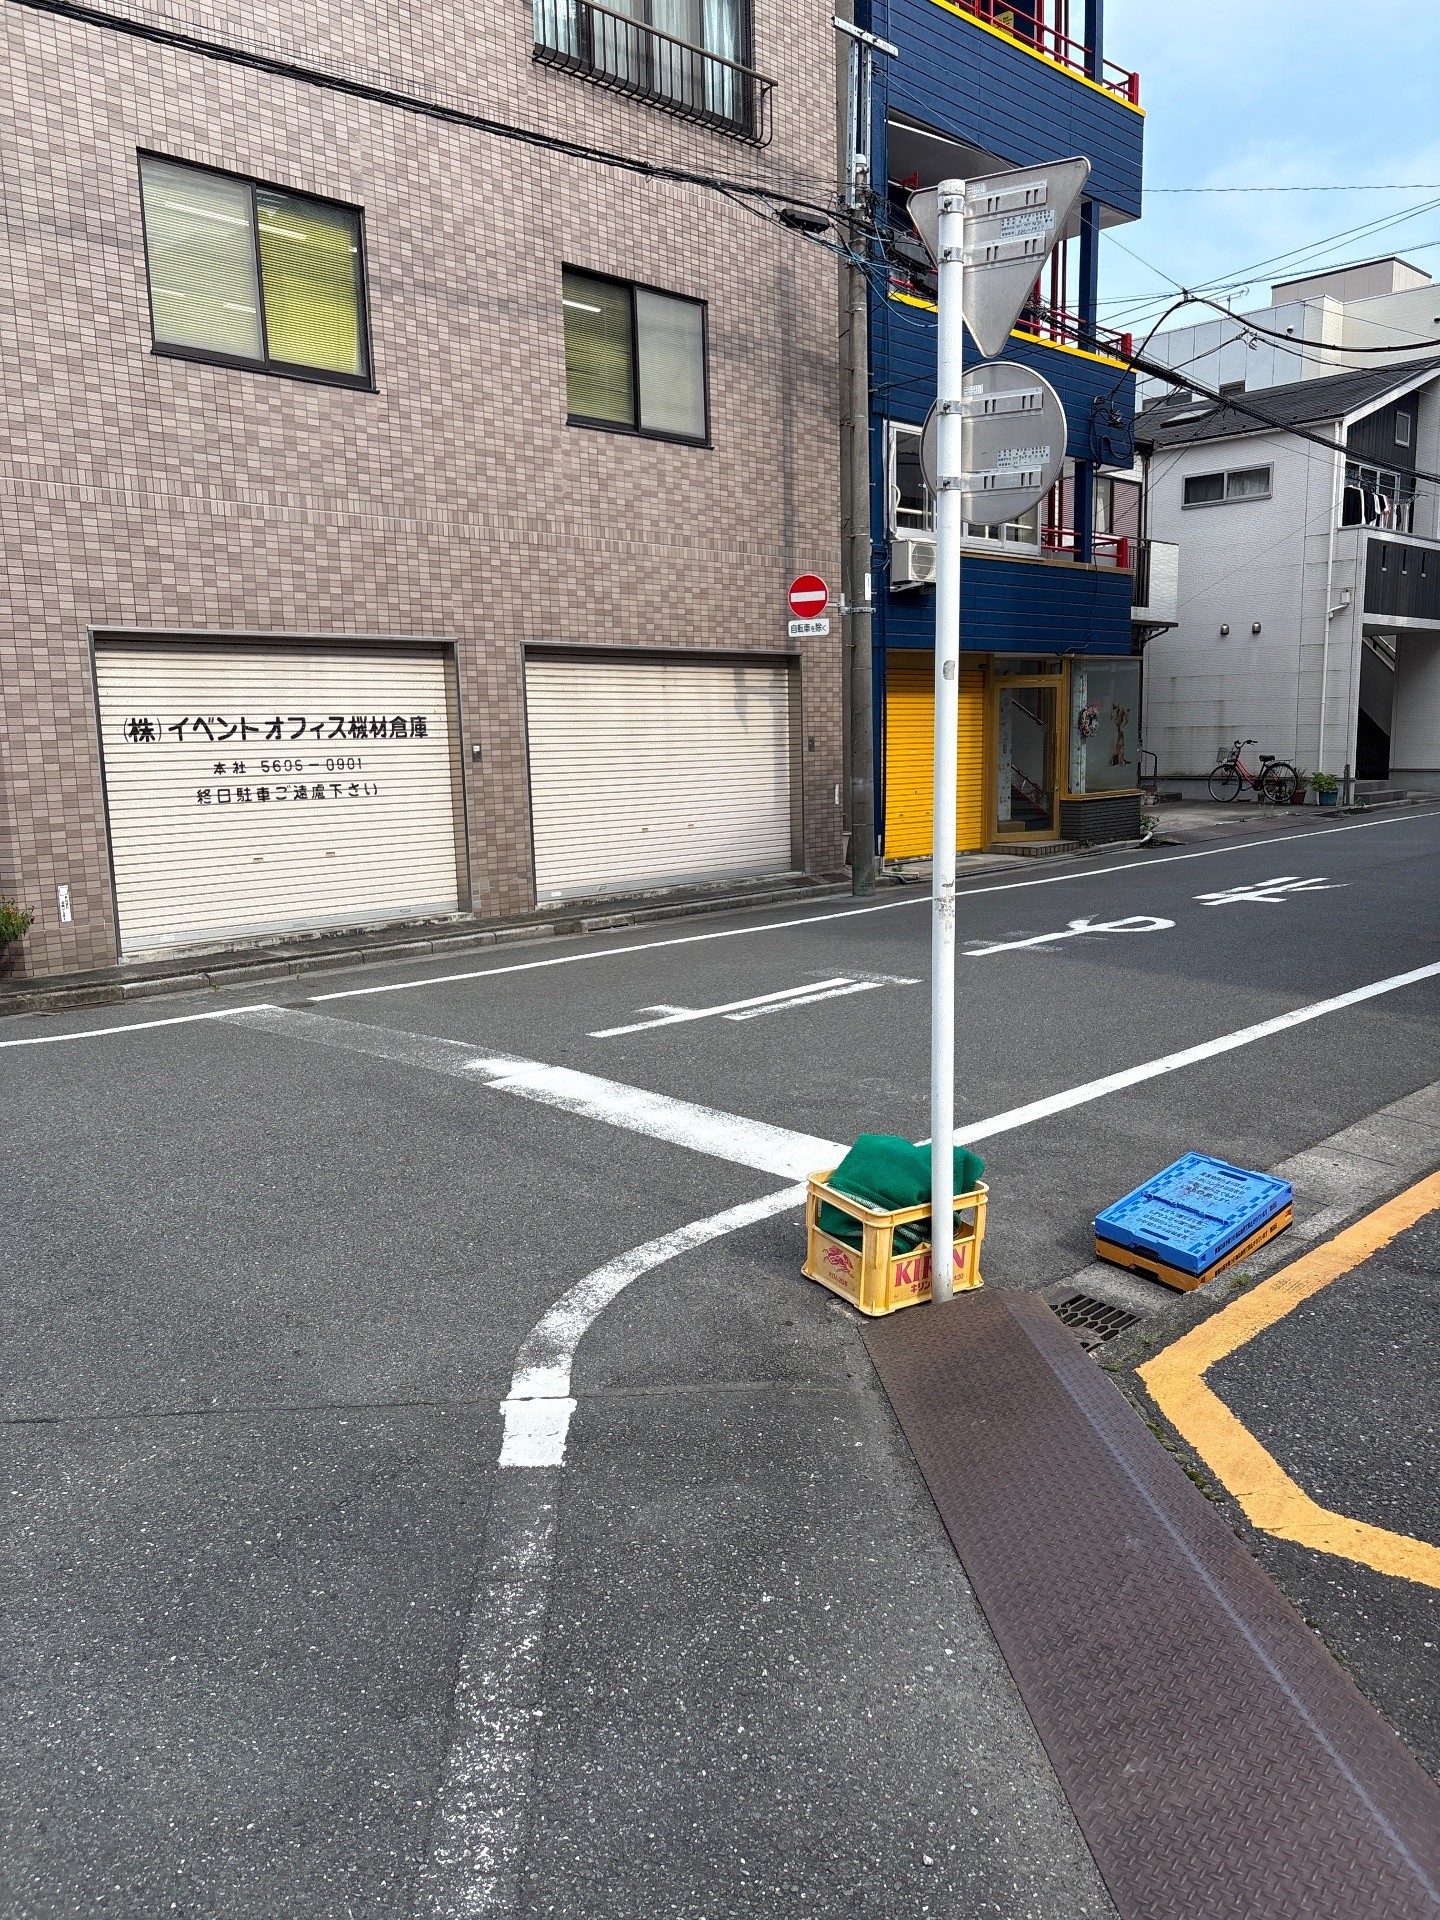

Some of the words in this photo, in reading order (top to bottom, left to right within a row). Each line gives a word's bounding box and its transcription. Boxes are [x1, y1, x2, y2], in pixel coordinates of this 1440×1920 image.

[790, 623, 827, 634] 自転車を除く
[213, 760, 246, 775] 本社
[196, 783, 378, 804] 終日駐車ご遠慮下さい
[894, 1245, 966, 1288] KIRN
